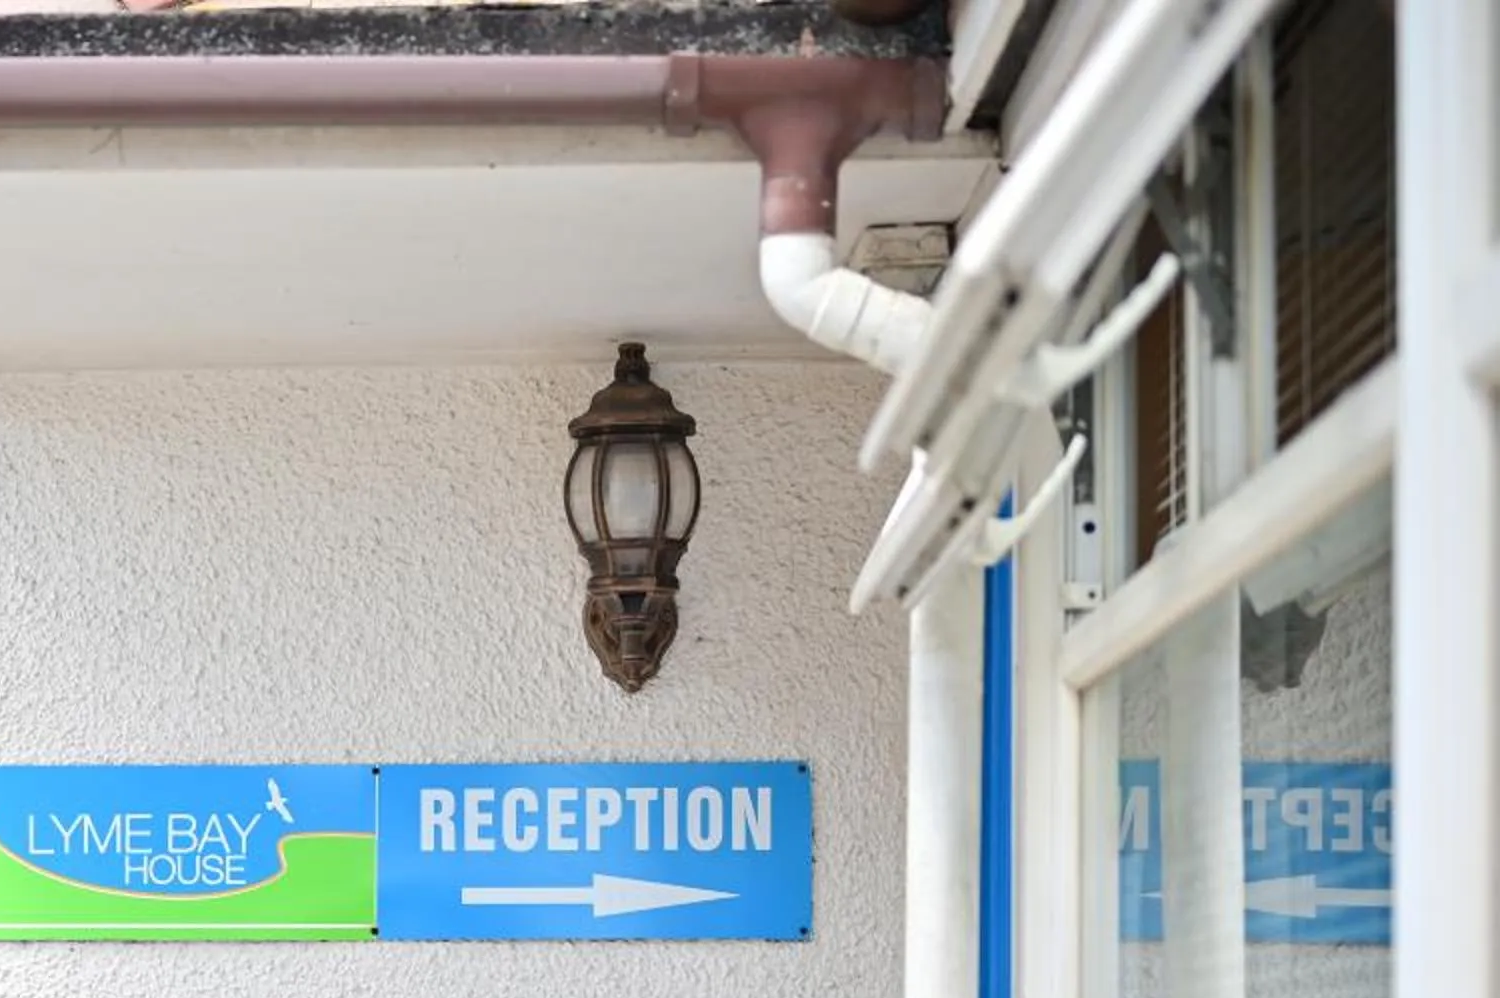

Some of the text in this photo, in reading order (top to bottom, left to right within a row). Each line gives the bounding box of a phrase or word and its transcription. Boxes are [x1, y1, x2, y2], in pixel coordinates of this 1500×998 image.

[28, 813, 262, 854] LYME BAY
[419, 786, 772, 852] RECEPTION
[124, 854, 247, 885] HOUSE
